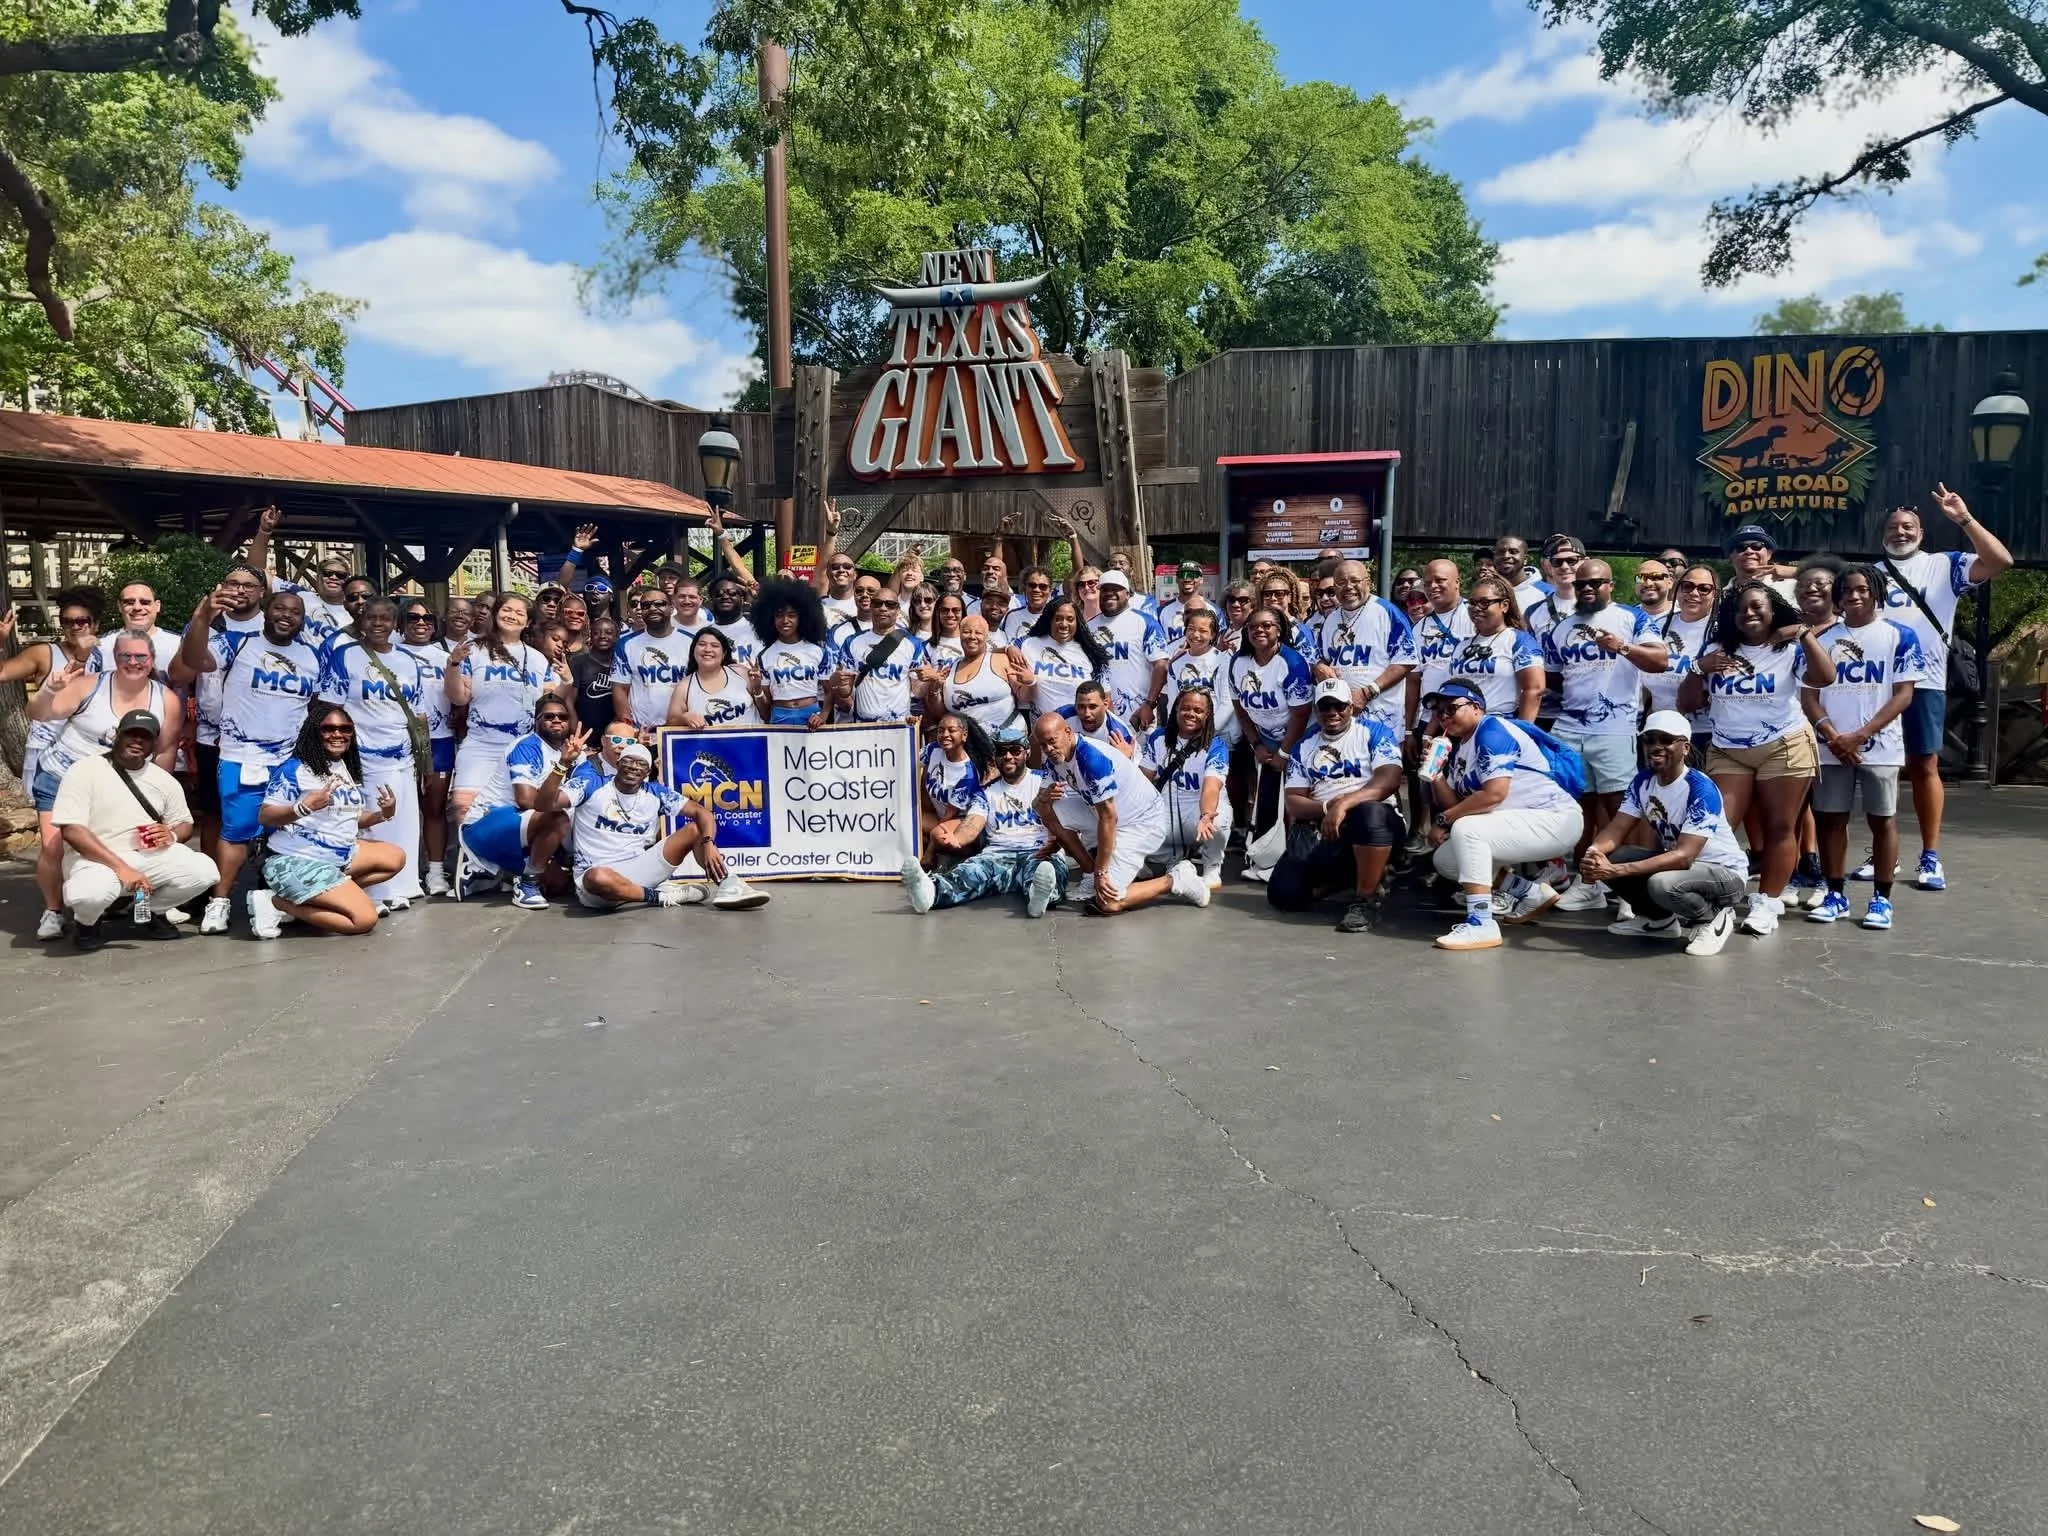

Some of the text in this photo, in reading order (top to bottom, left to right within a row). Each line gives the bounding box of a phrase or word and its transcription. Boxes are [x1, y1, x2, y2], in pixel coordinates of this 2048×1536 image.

[918, 250, 993, 286] NEW
[888, 303, 1036, 365] TEXAS
[1702, 346, 1885, 433] DINO
[850, 361, 1076, 473] GIANT
[1725, 474, 1849, 498] OFF ROAD
[1725, 495, 1848, 516] ADVENTURE
[304, 615, 338, 640] MC
[1328, 645, 1371, 667] MCN
[1451, 656, 1497, 674] MCN
[484, 664, 538, 689] MCN
[637, 664, 686, 684] MCN
[773, 664, 816, 684] MCN
[1034, 661, 1085, 679] MCN
[251, 667, 313, 697] MCN
[1711, 672, 1775, 695] MCN
[703, 703, 746, 726] MCN
[784, 744, 895, 770] Melanin
[1158, 765, 1200, 790] CN
[1308, 759, 1362, 779] MCN
[681, 780, 763, 811] MCN
[785, 776, 896, 801] Coaster
[595, 815, 650, 834] MCN
[725, 811, 763, 820] Coaster
[787, 808, 897, 833] Network
[995, 808, 1042, 830] MCN
[766, 852, 830, 866] Coaster
[836, 851, 873, 865] Club
